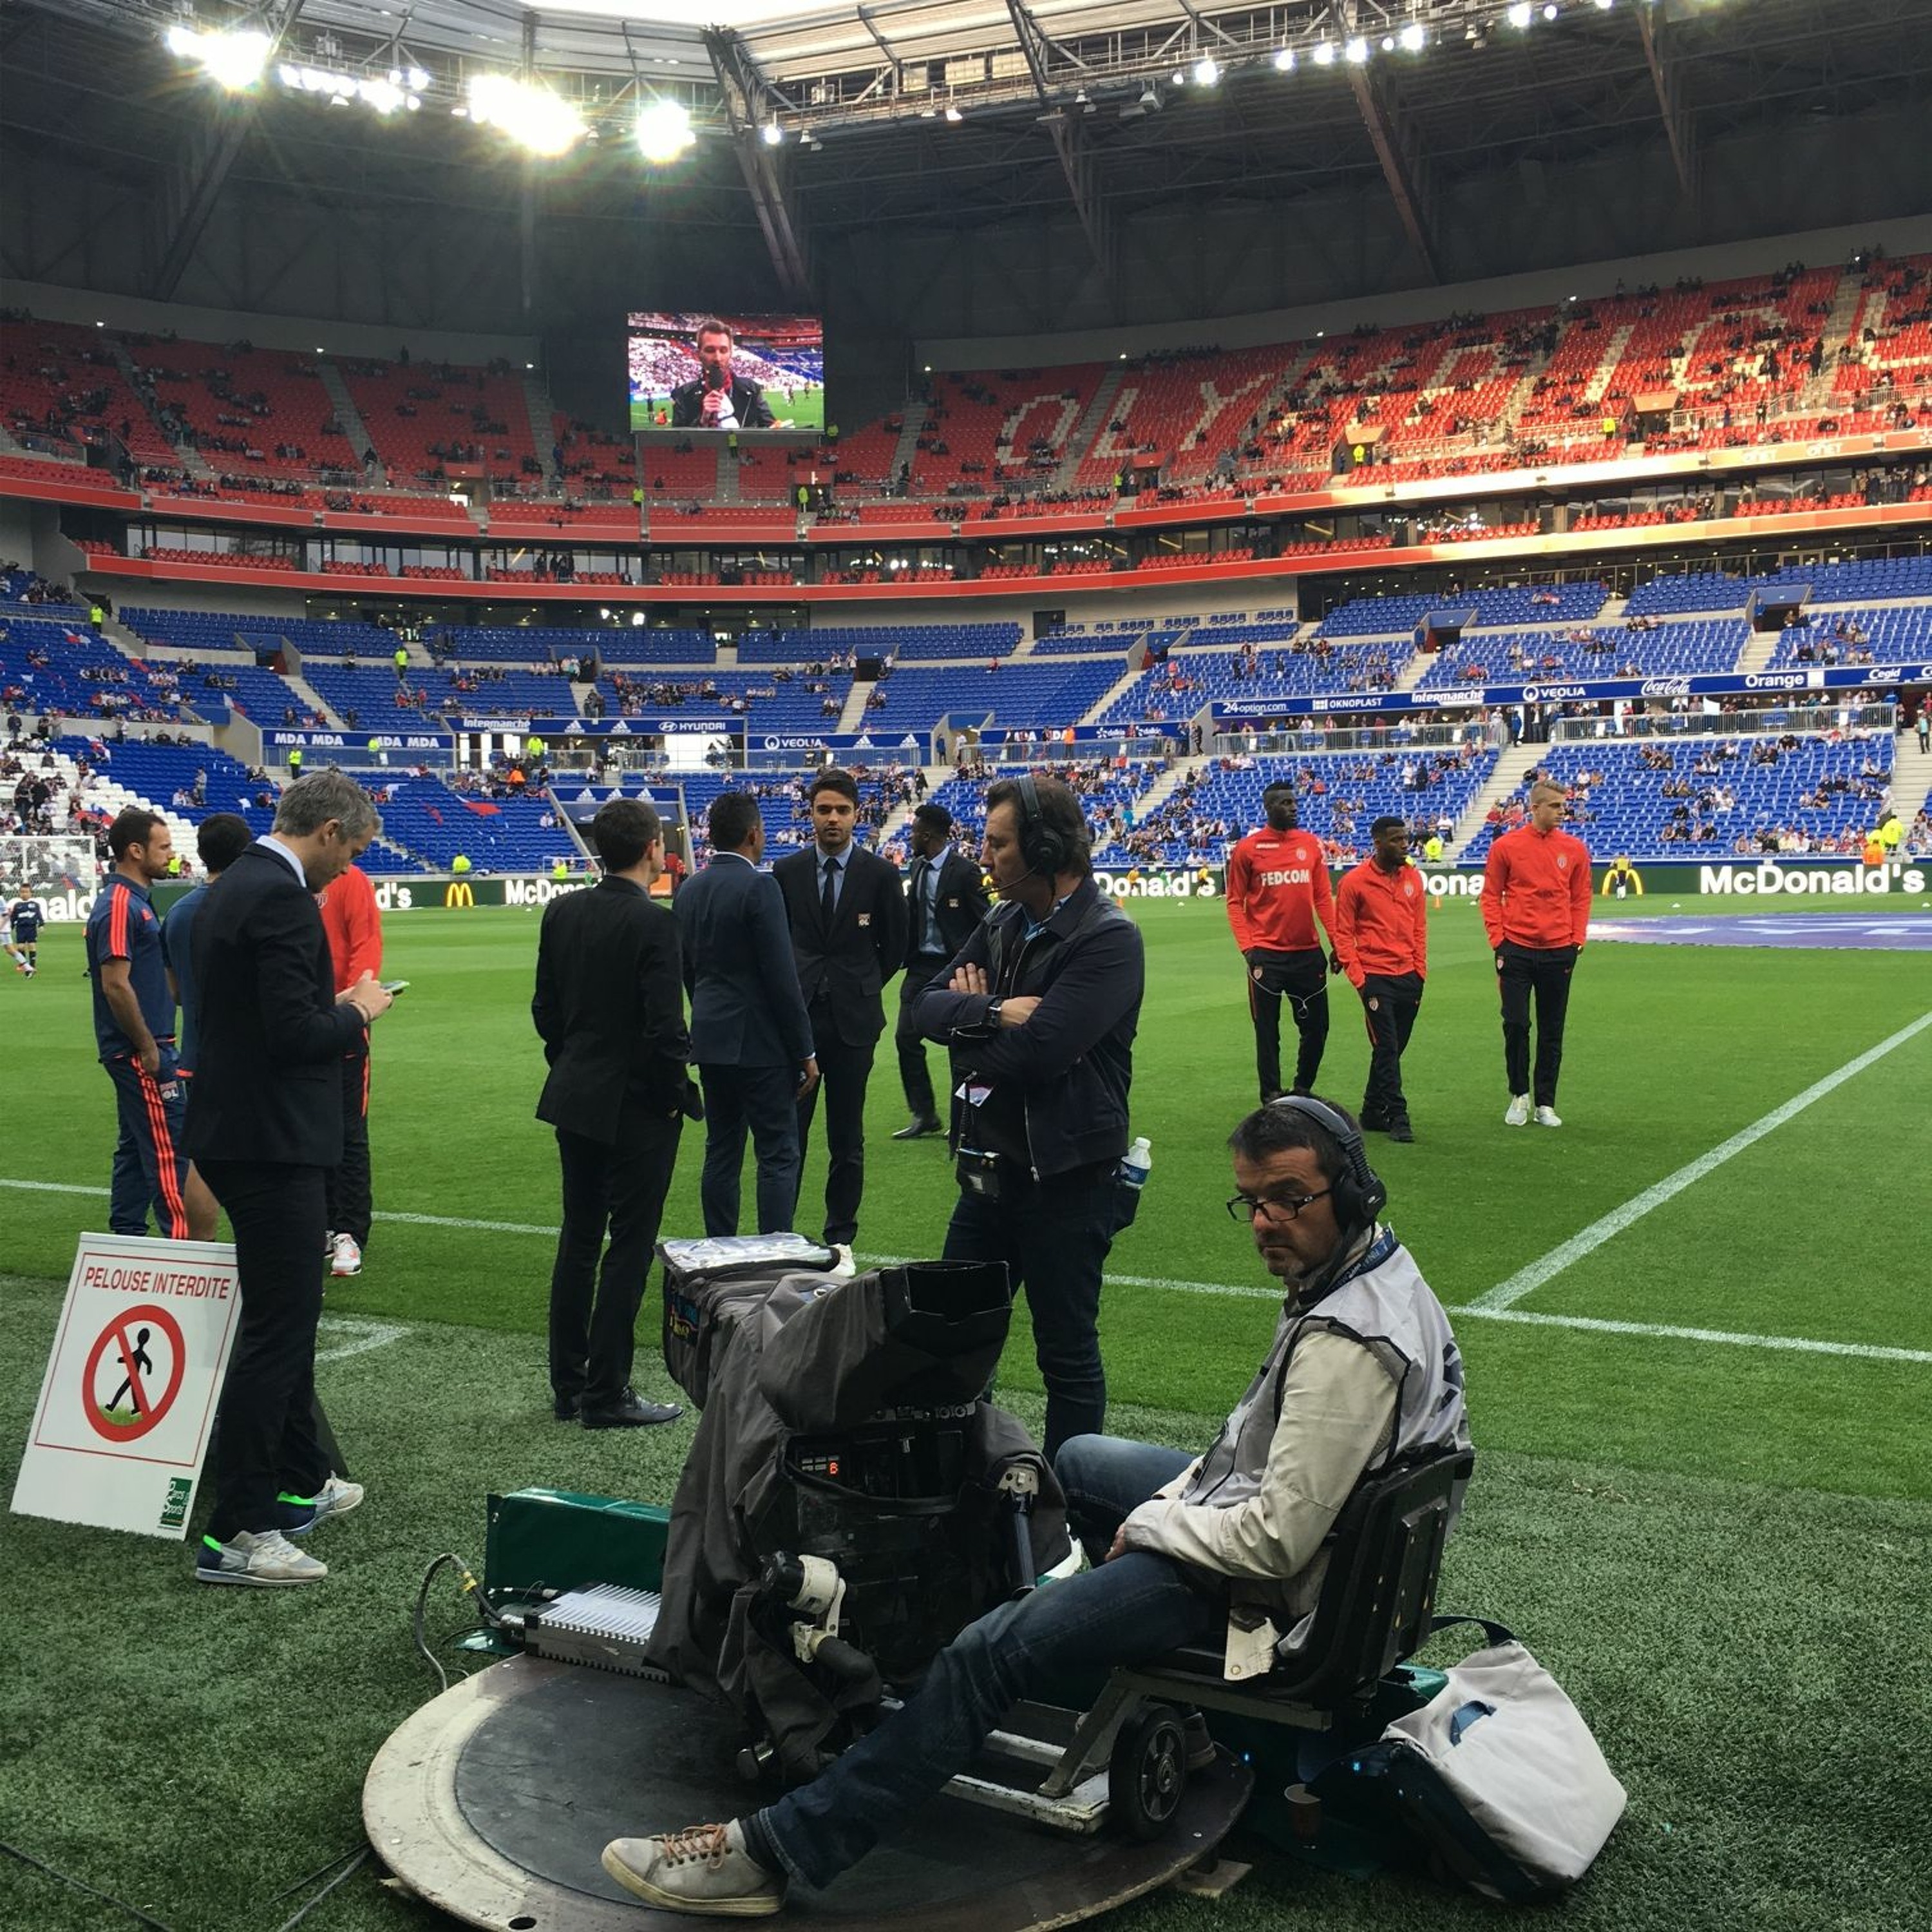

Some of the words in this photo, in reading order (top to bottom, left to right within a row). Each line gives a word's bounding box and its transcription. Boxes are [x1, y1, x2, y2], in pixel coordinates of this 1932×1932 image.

[1869, 668, 1902, 680] Cegid
[1745, 674, 1804, 688] Orange
[1540, 687, 1586, 697] VEOLIA
[1222, 701, 1287, 714] 24option.com
[1330, 697, 1383, 708] OKNOPLAST
[679, 722, 726, 731] HYUNDAI
[274, 733, 307, 744] MDA
[312, 734, 344, 746] MDA
[407, 737, 440, 748] MDA
[781, 738, 822, 747] VEOLIA
[1261, 869, 1310, 886] FEDCOM
[1700, 864, 1926, 894] McDonald's
[84, 1267, 151, 1292] PELOUSE
[152, 1273, 231, 1300] INTERDITE
